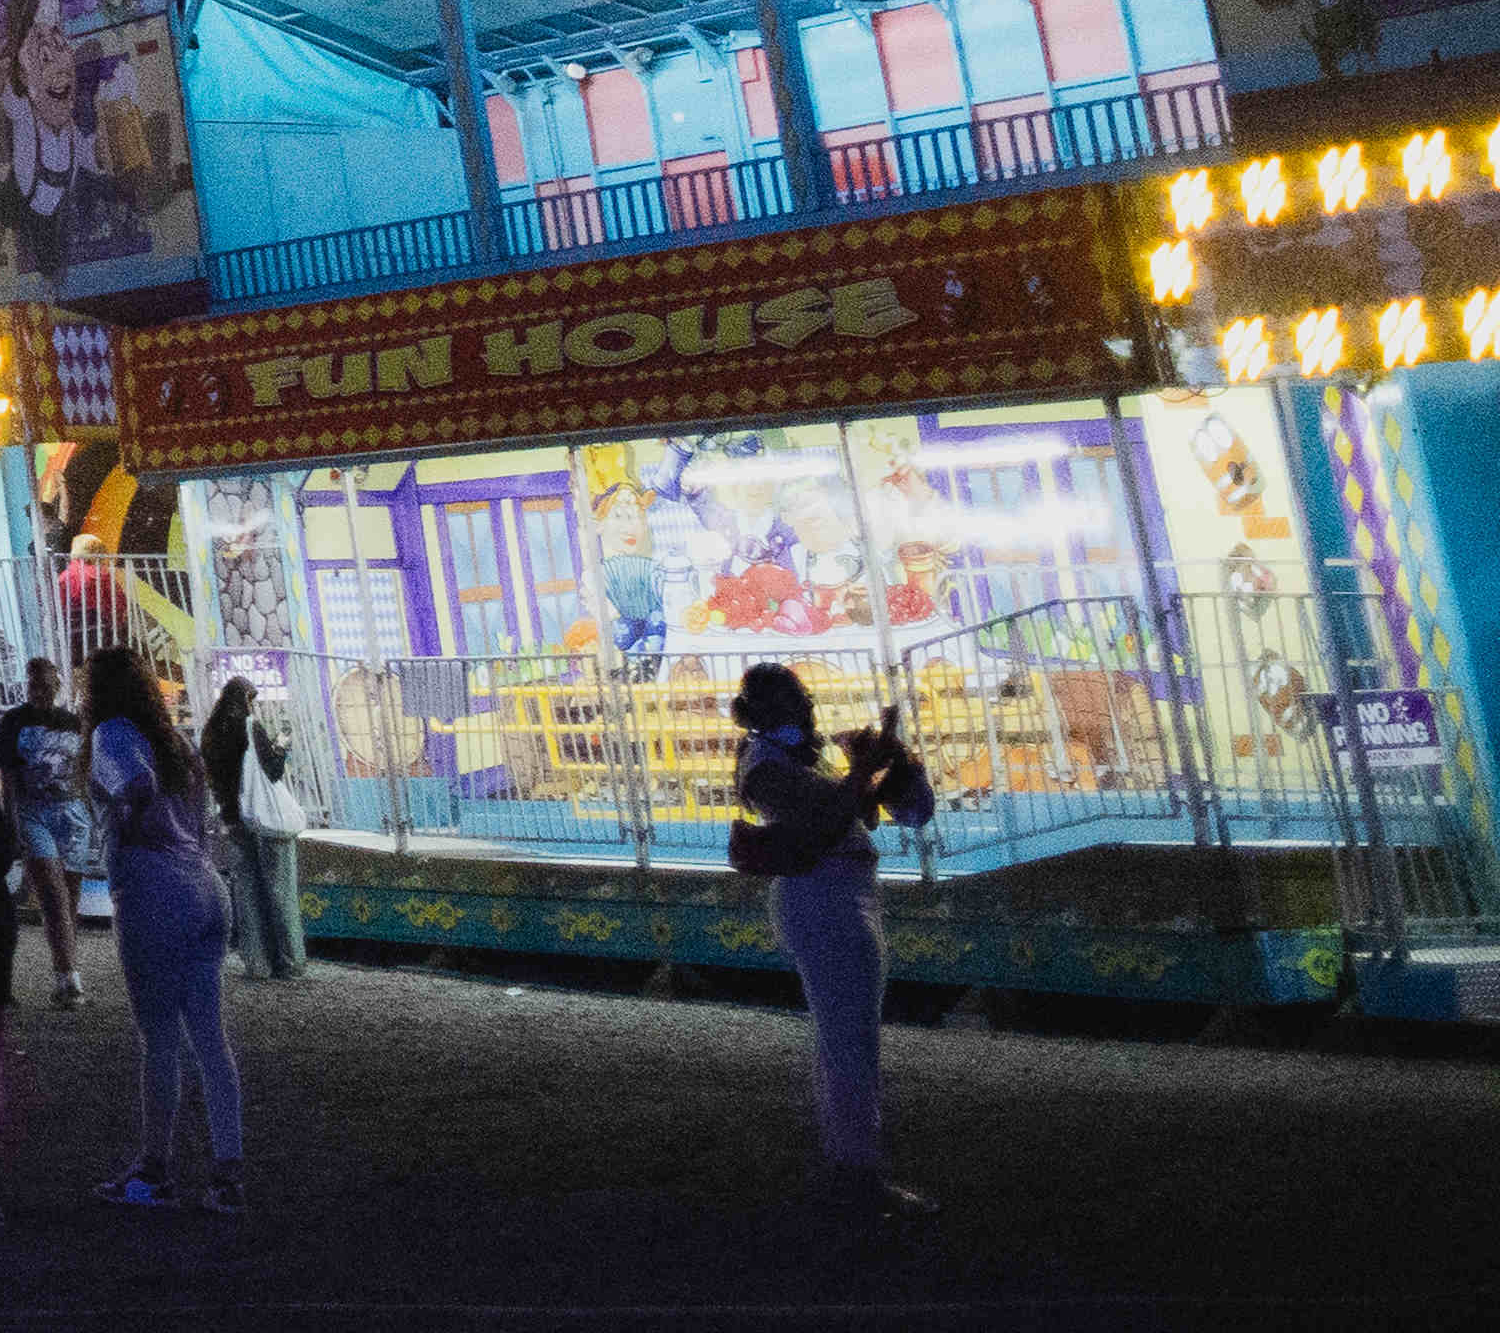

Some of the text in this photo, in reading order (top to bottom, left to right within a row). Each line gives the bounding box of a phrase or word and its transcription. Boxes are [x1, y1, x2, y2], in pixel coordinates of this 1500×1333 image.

[244, 276, 920, 407] FUN HOUSE
[230, 654, 253, 671] NO
[1356, 701, 1390, 724] NO
[1331, 721, 1429, 747] RNNING
